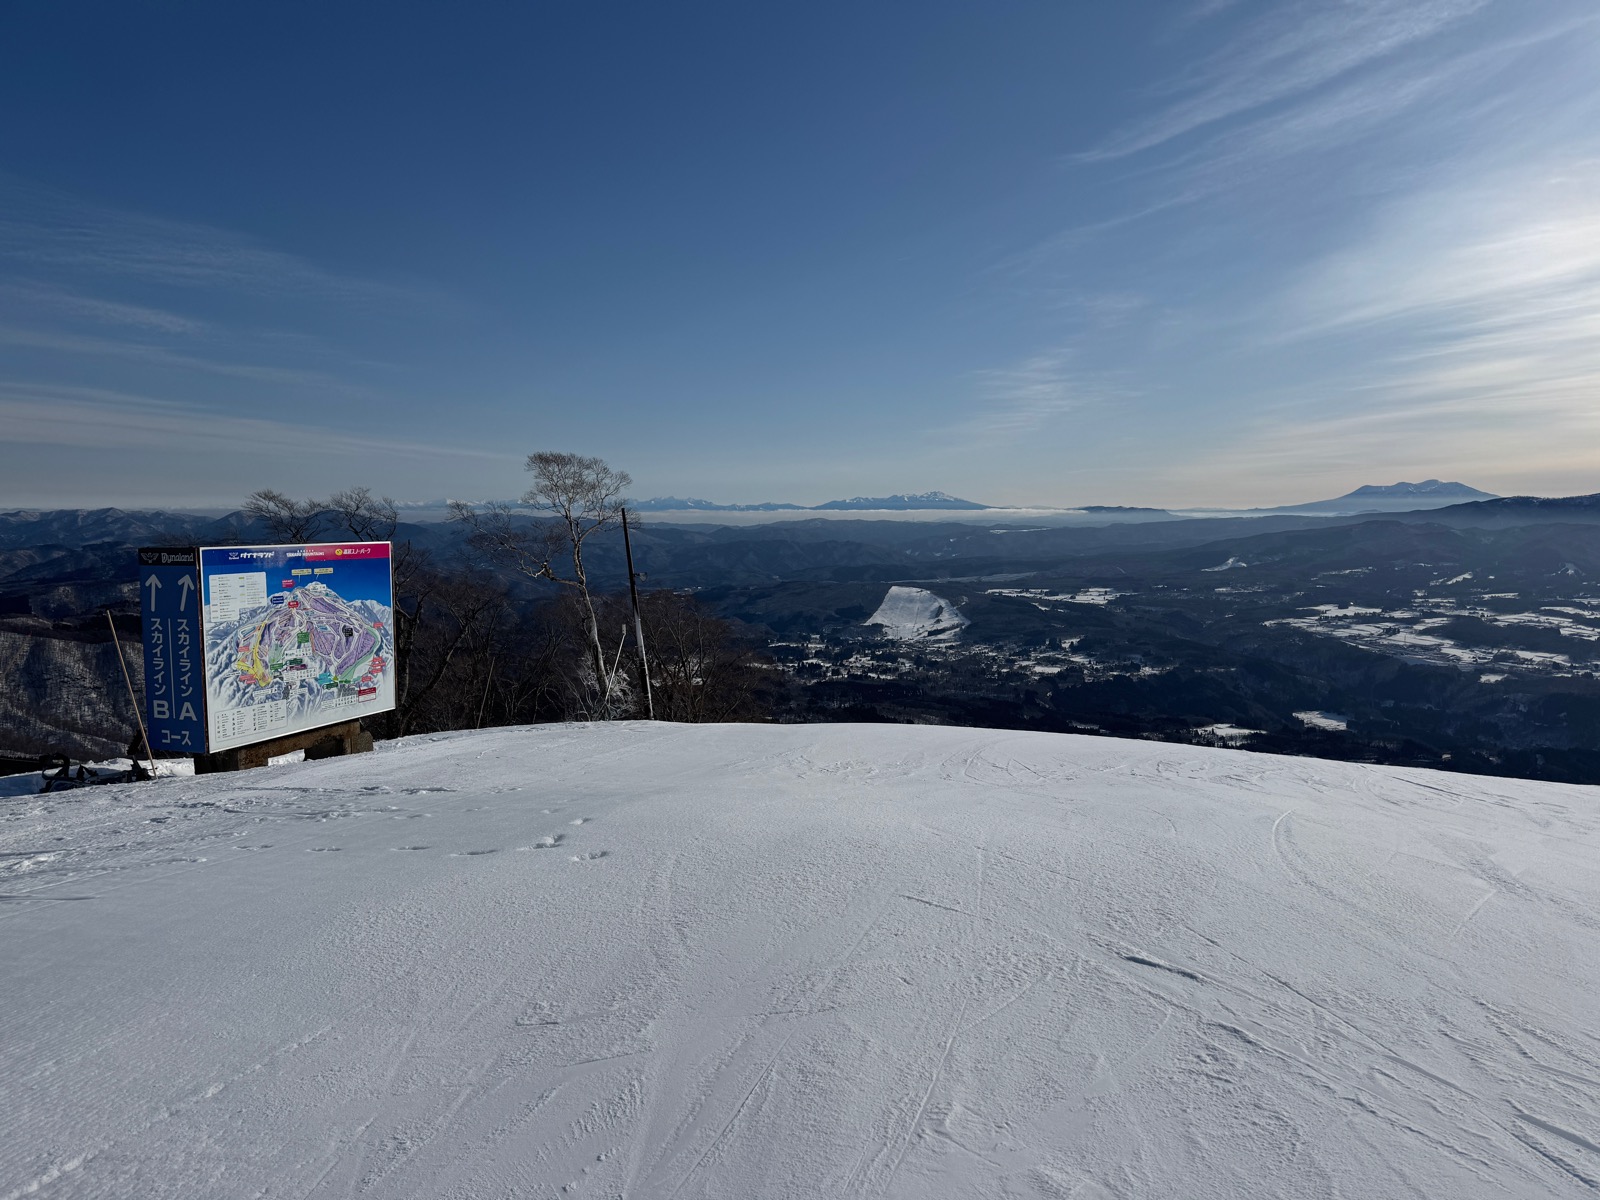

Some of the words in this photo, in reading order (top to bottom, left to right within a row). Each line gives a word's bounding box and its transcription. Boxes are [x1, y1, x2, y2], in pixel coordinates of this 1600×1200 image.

[161, 552, 194, 564] Dynaland
[161, 729, 192, 746] コース
